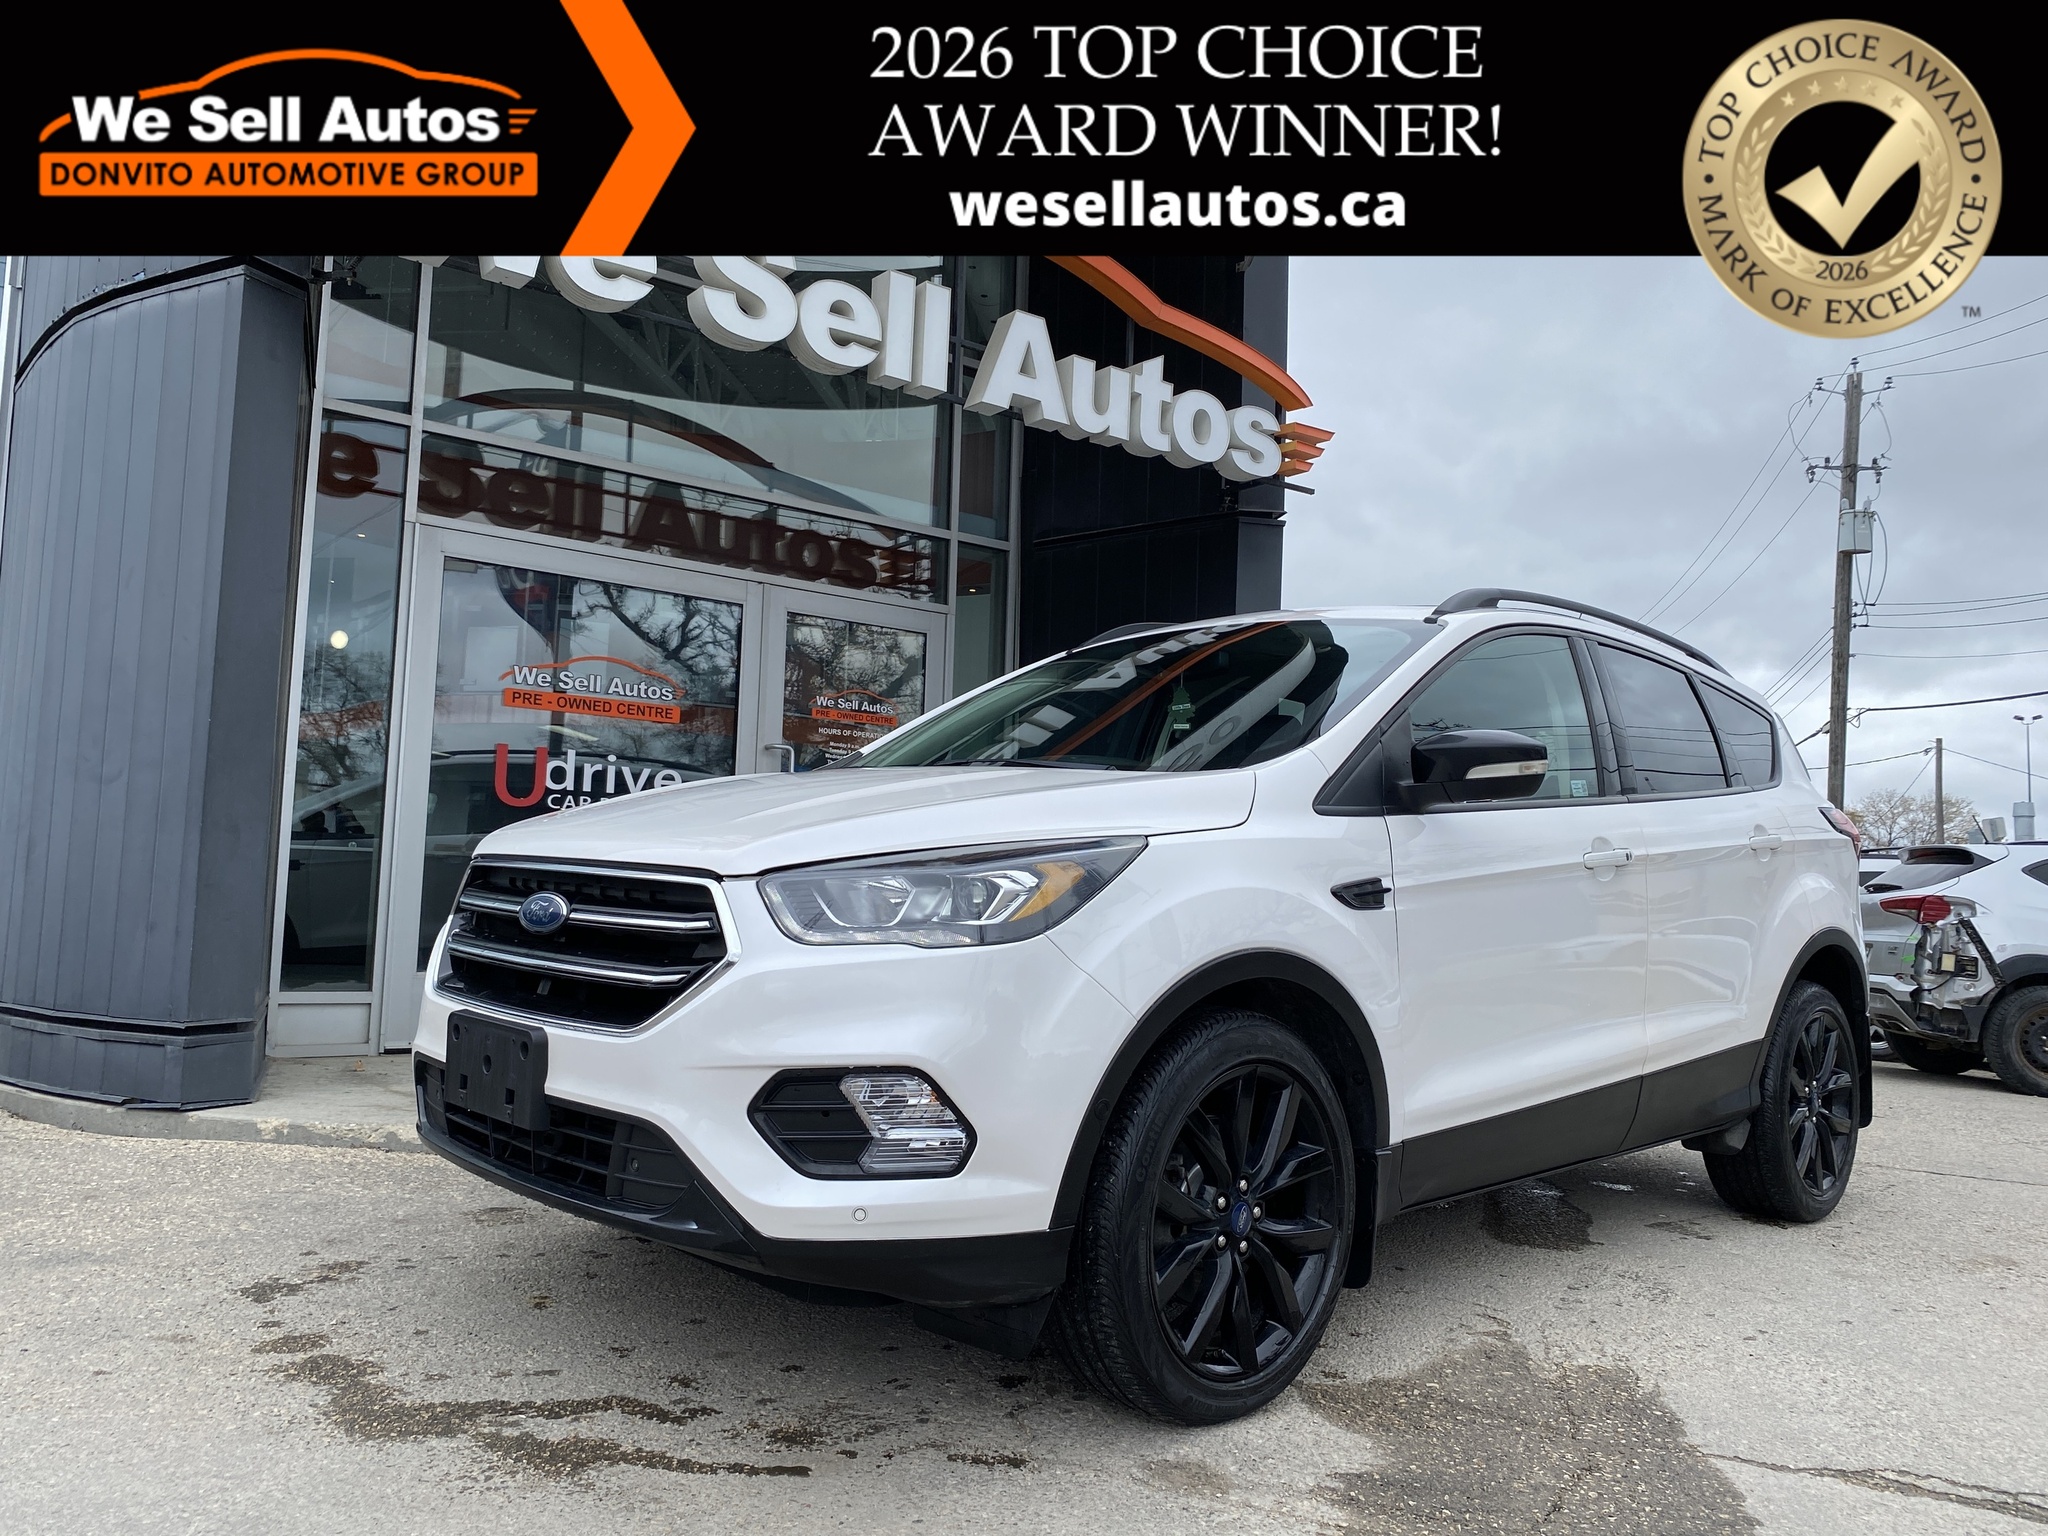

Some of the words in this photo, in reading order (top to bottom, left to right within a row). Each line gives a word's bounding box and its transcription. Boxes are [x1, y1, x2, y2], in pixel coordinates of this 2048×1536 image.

[687, 256, 953, 400] Sell
[964, 309, 1283, 483] Autos
[513, 665, 551, 687] We
[558, 671, 601, 693] Sell
[607, 677, 674, 701] Autos
[512, 691, 543, 706] PRE
[556, 696, 612, 713] OWNED
[616, 702, 674, 720] CENTRE
[816, 695, 835, 708] We
[837, 698, 858, 711] Sell
[861, 701, 894, 714] Autos
[815, 709, 831, 718] PRE
[836, 712, 864, 721] OWNED
[865, 715, 894, 725] CENTRE
[818, 727, 842, 736] HOURS
[842, 729, 852, 737] OF
[852, 730, 886, 739] OPERATIO
[526, 899, 554, 923] Ford
